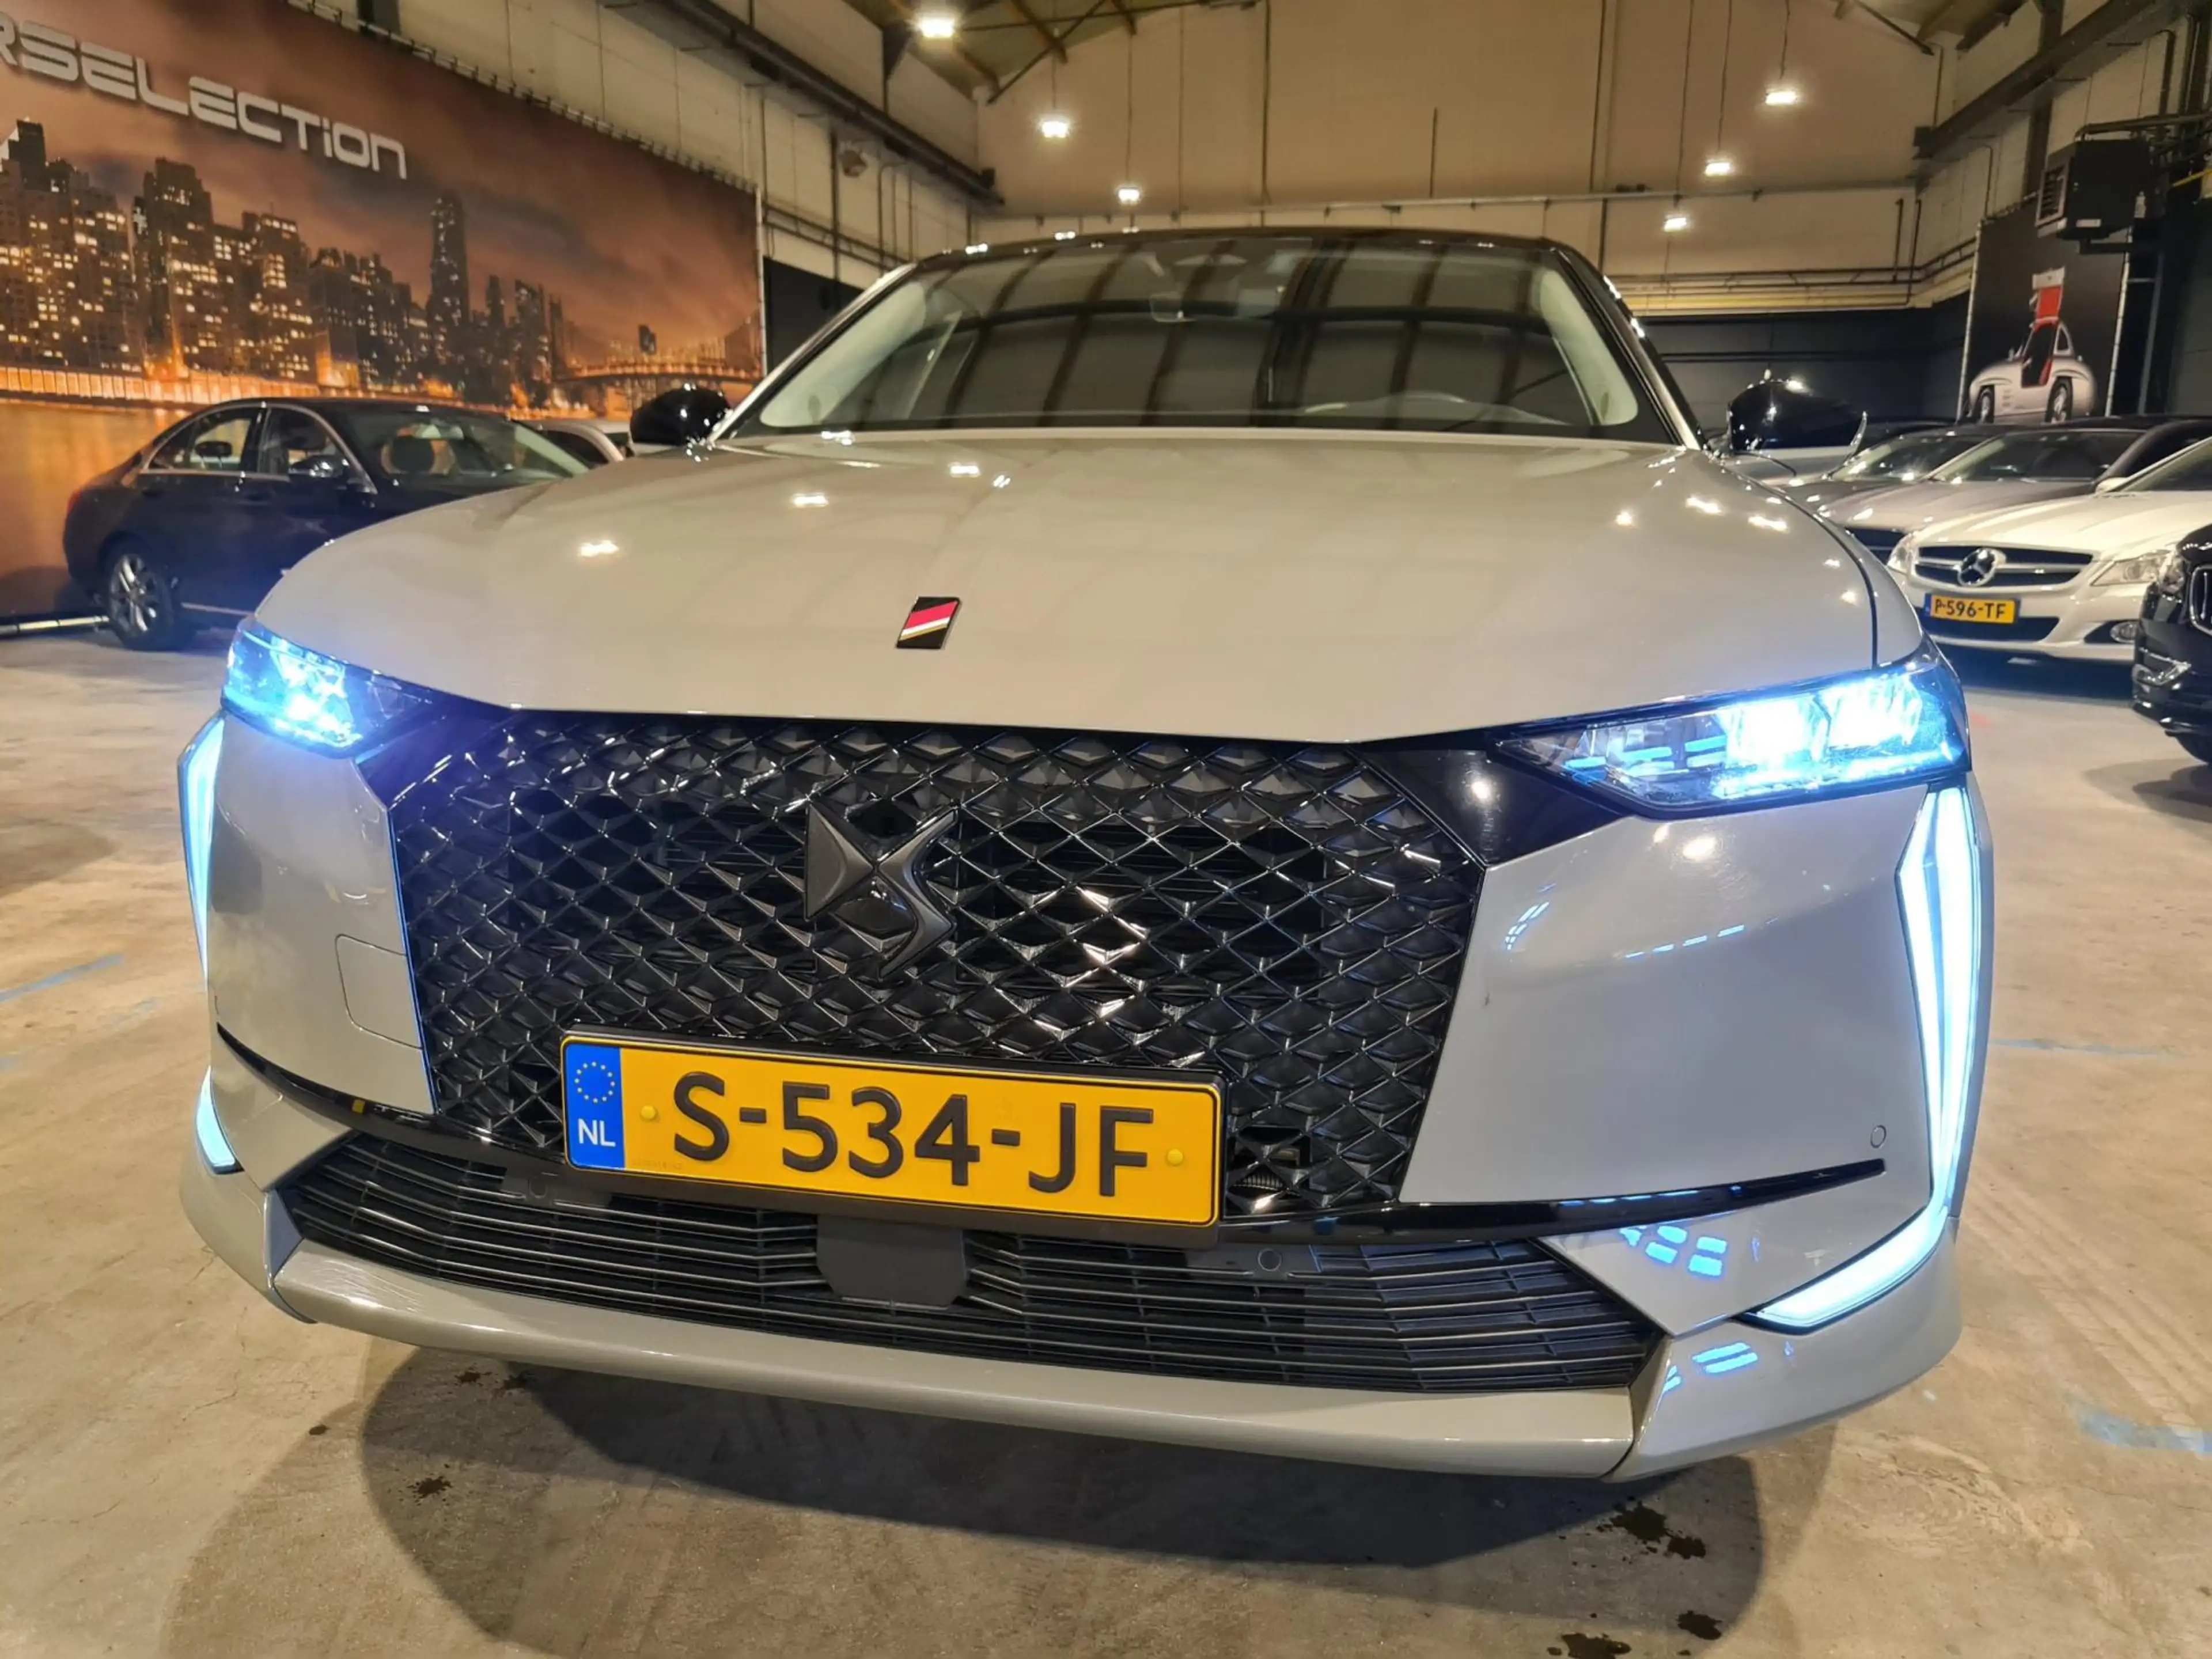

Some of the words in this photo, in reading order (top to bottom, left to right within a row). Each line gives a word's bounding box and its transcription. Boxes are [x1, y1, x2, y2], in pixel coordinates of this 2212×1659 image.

[1934, 599, 2006, 619] P-596-TF
[578, 1118, 616, 1147] NL
[673, 1071, 1154, 1198] S-534-JF
